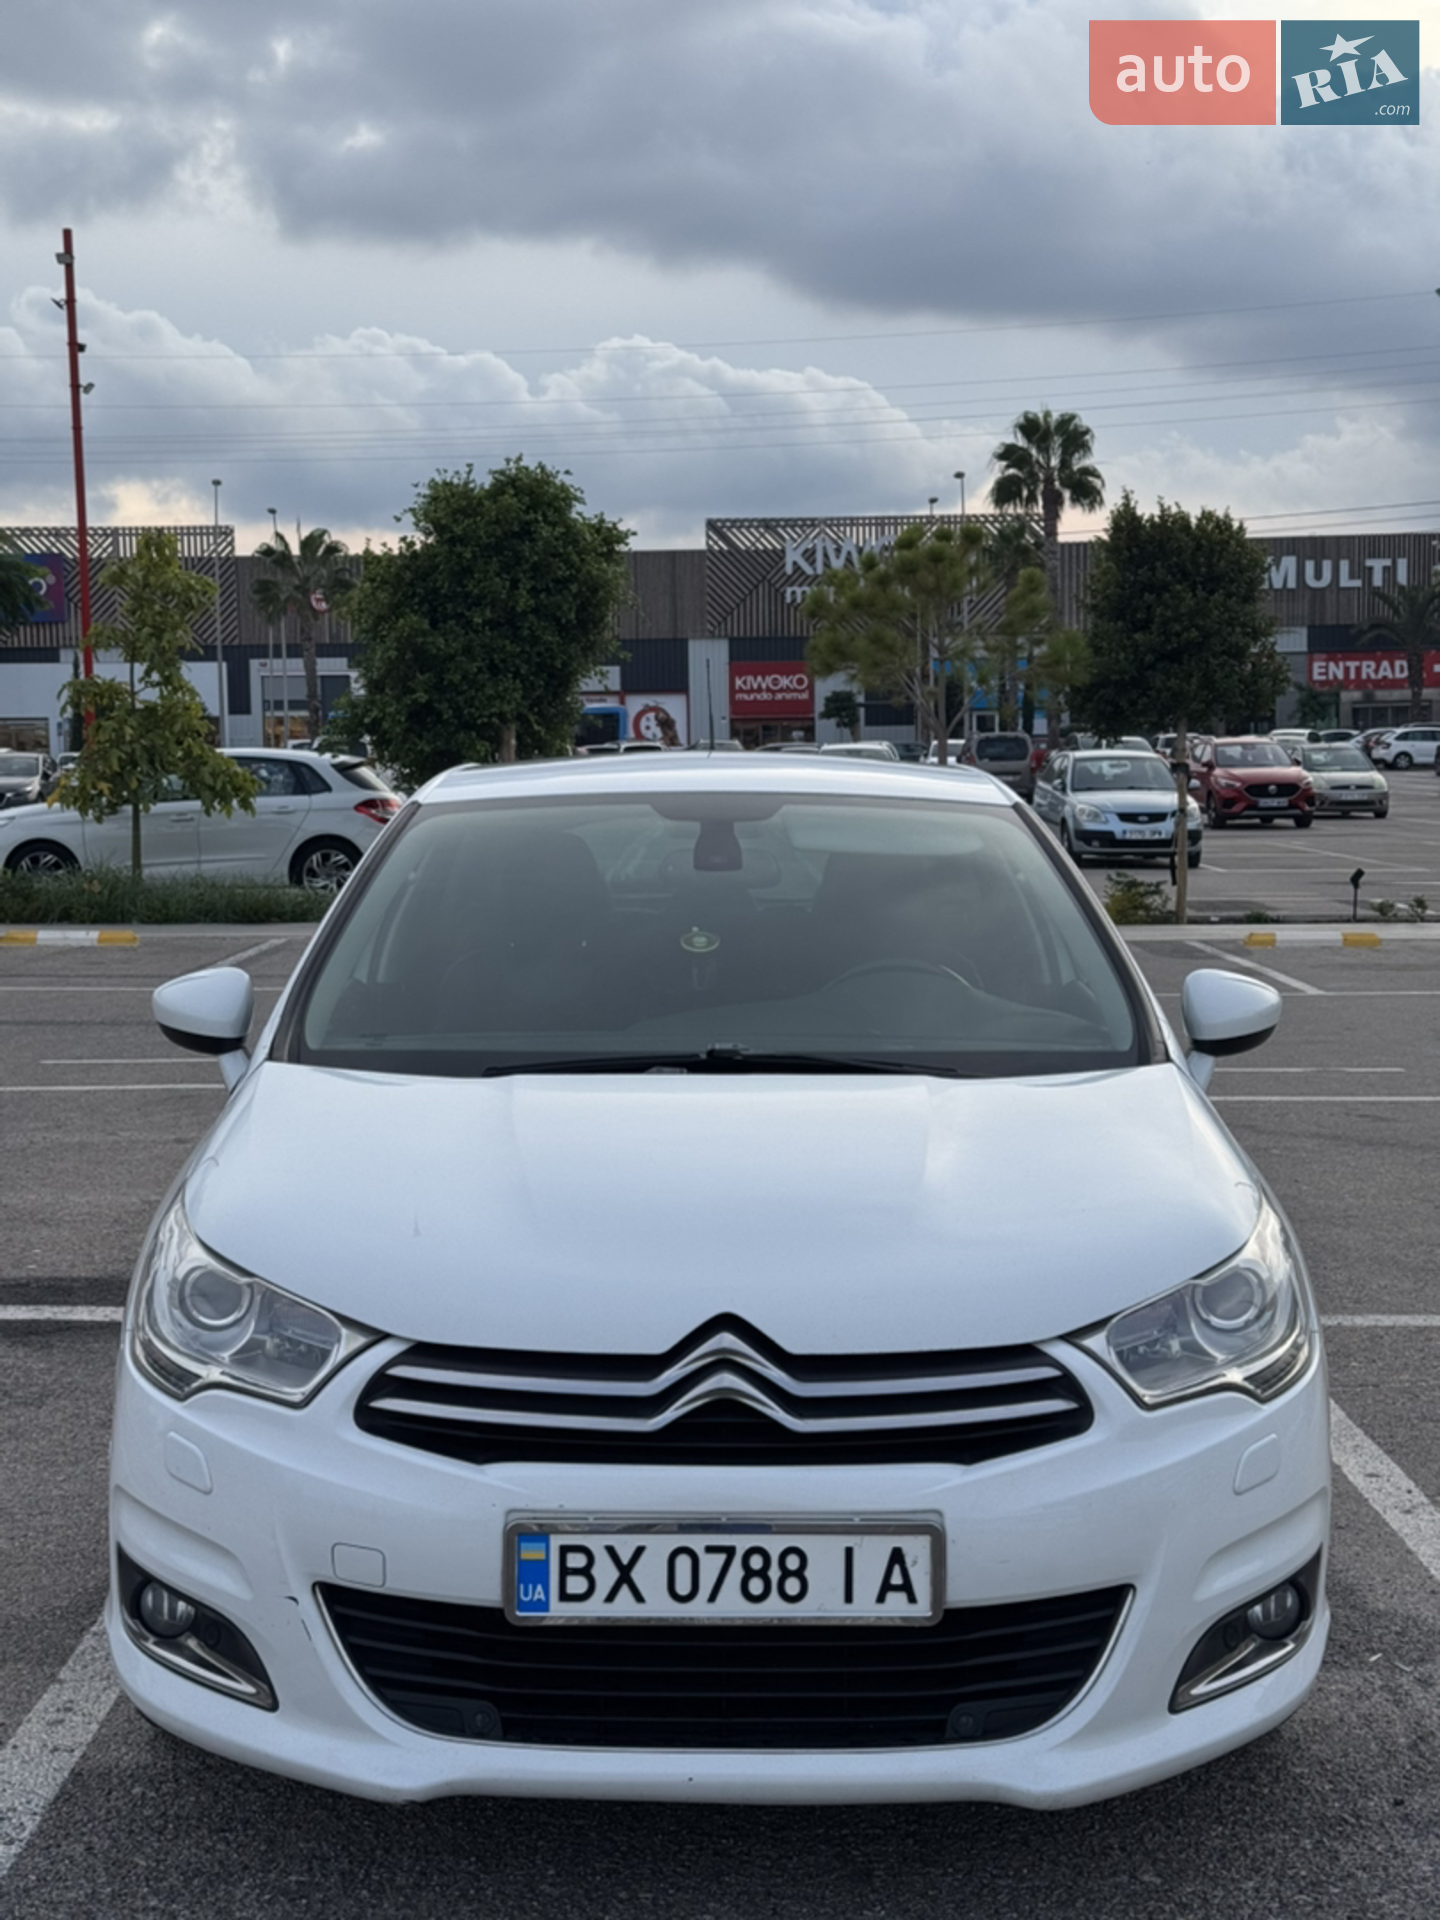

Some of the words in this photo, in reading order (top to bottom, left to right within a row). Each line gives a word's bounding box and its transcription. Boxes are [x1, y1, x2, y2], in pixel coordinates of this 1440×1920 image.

[1262, 555, 1408, 589] MULTI
[1312, 659, 1420, 681] ENTRAD
[735, 674, 809, 691] KIWOKO
[735, 690, 773, 701] mundo
[775, 689, 810, 700] animal
[558, 1545, 647, 1604] BX
[666, 1545, 809, 1604] 0788
[519, 1583, 547, 1602] UA
